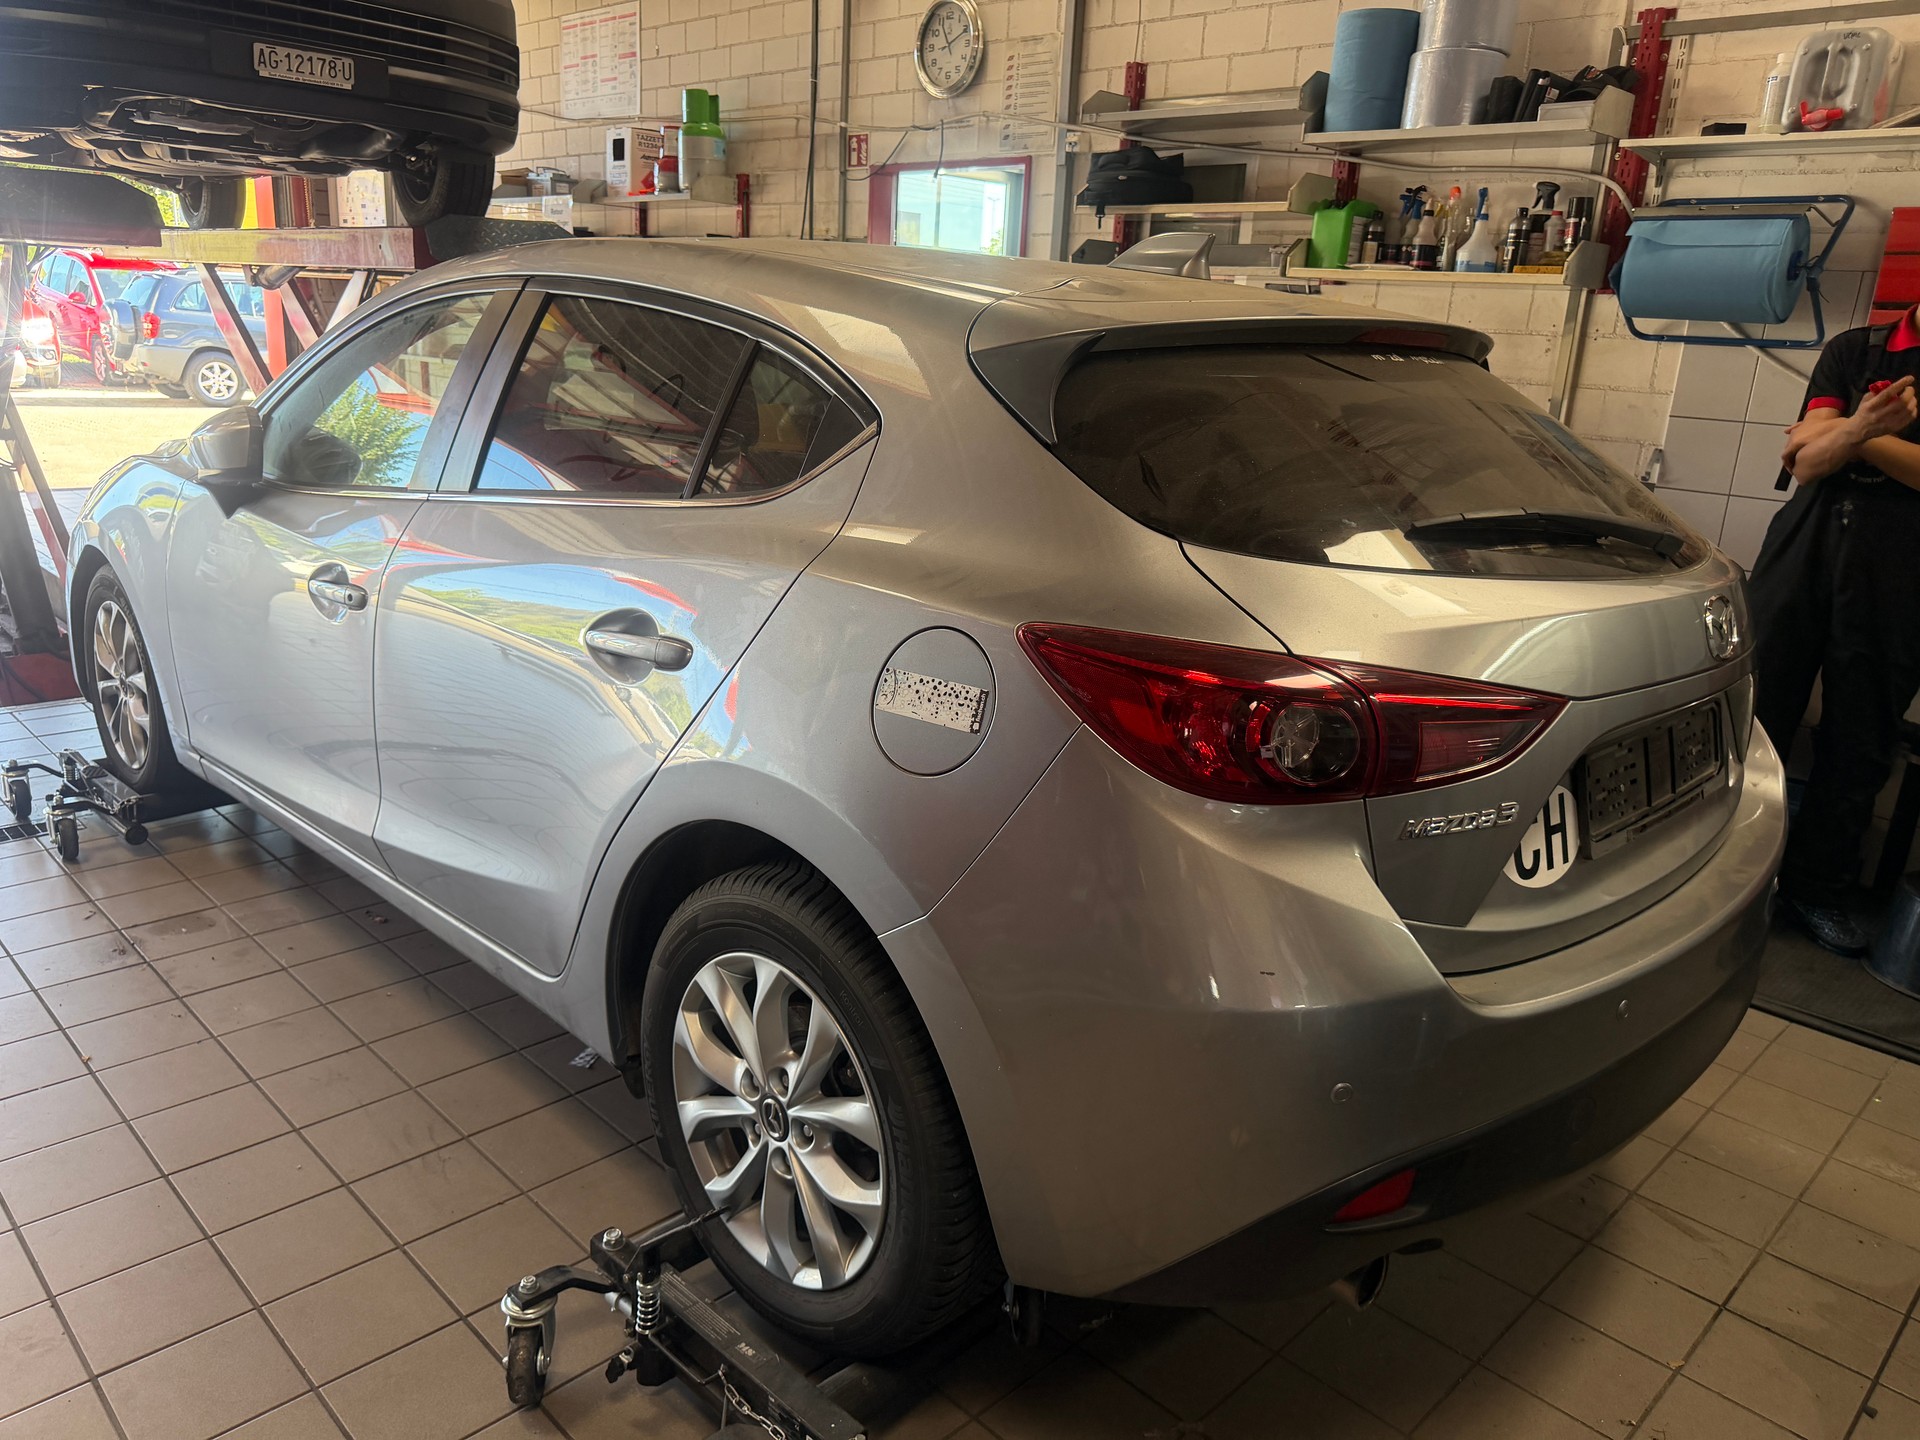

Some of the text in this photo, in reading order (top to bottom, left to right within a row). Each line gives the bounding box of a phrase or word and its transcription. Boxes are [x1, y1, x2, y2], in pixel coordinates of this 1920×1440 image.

[946, 11, 954, 20] 12
[931, 28, 940, 37] 10
[928, 43, 935, 52] 9
[964, 39, 970, 47] 3
[930, 58, 937, 67] 8
[961, 54, 967, 62] 4
[937, 67, 943, 76] 7
[954, 65, 961, 74] 5
[945, 71, 951, 80] 6
[1513, 792, 1569, 881] CH
[840, 989, 864, 1027] Kontrol
